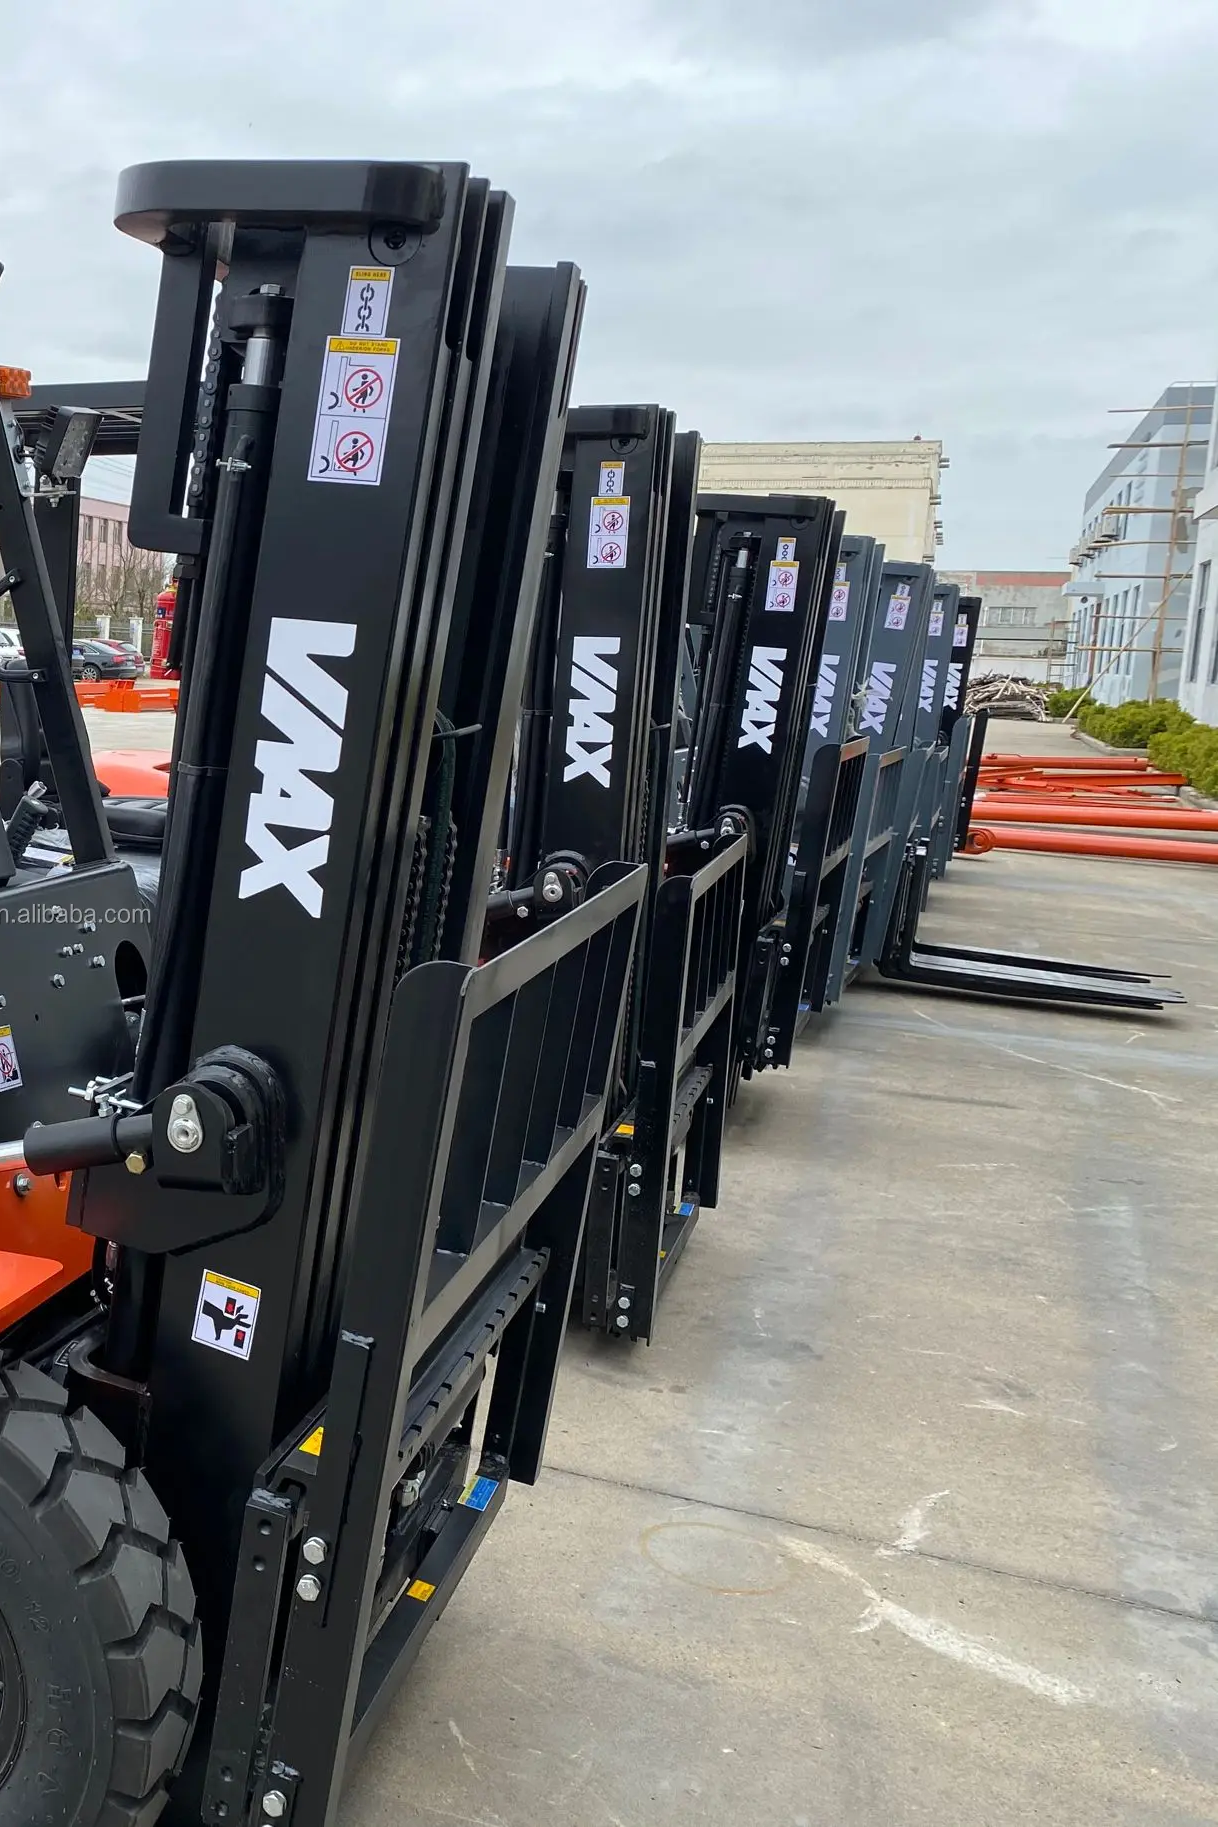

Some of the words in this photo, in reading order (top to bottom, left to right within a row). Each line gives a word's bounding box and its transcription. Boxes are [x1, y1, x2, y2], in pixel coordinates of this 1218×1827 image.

[562, 635, 621, 788] VMAX
[737, 645, 788, 755] VMAX
[810, 654, 841, 738] VMAX
[859, 661, 897, 735] VMAX
[918, 659, 939, 713] VMAX
[943, 662, 964, 711] VMAX
[238, 616, 358, 919] VMAX
